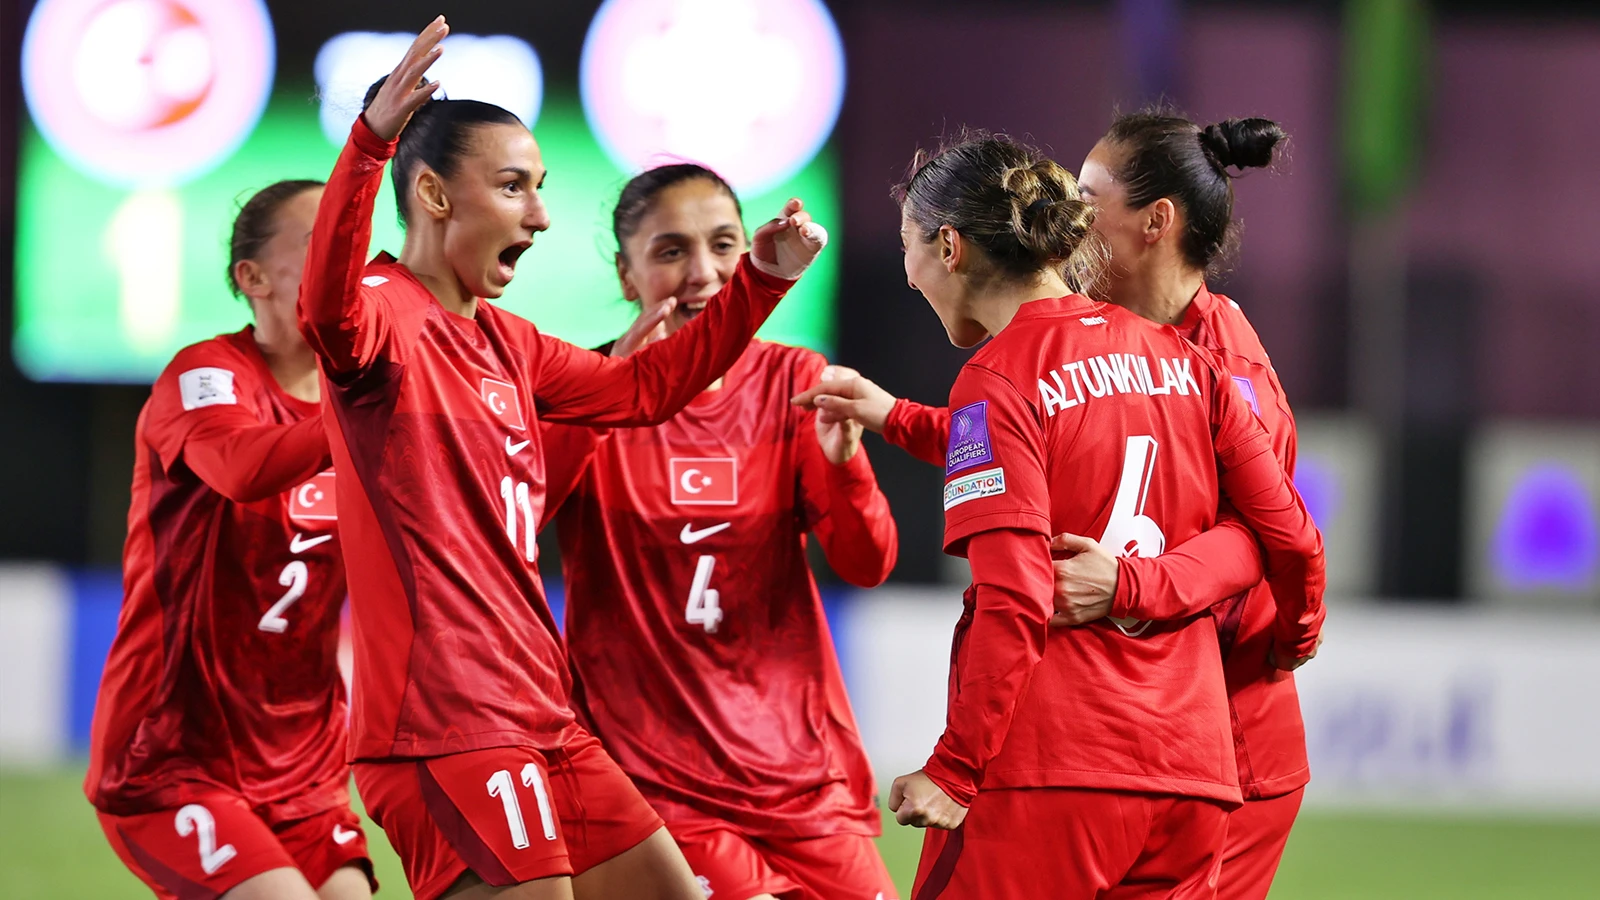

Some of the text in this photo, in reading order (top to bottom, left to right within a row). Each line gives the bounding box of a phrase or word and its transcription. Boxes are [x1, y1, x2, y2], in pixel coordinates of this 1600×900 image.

[948, 448, 987, 467] QUALIFIERS
[949, 441, 984, 460] EUROPEAN
[500, 476, 535, 562] 11
[1099, 434, 1167, 637] 6
[258, 561, 308, 633] 2
[685, 555, 723, 633] 4
[174, 804, 237, 875] 2
[486, 762, 557, 850] 11
